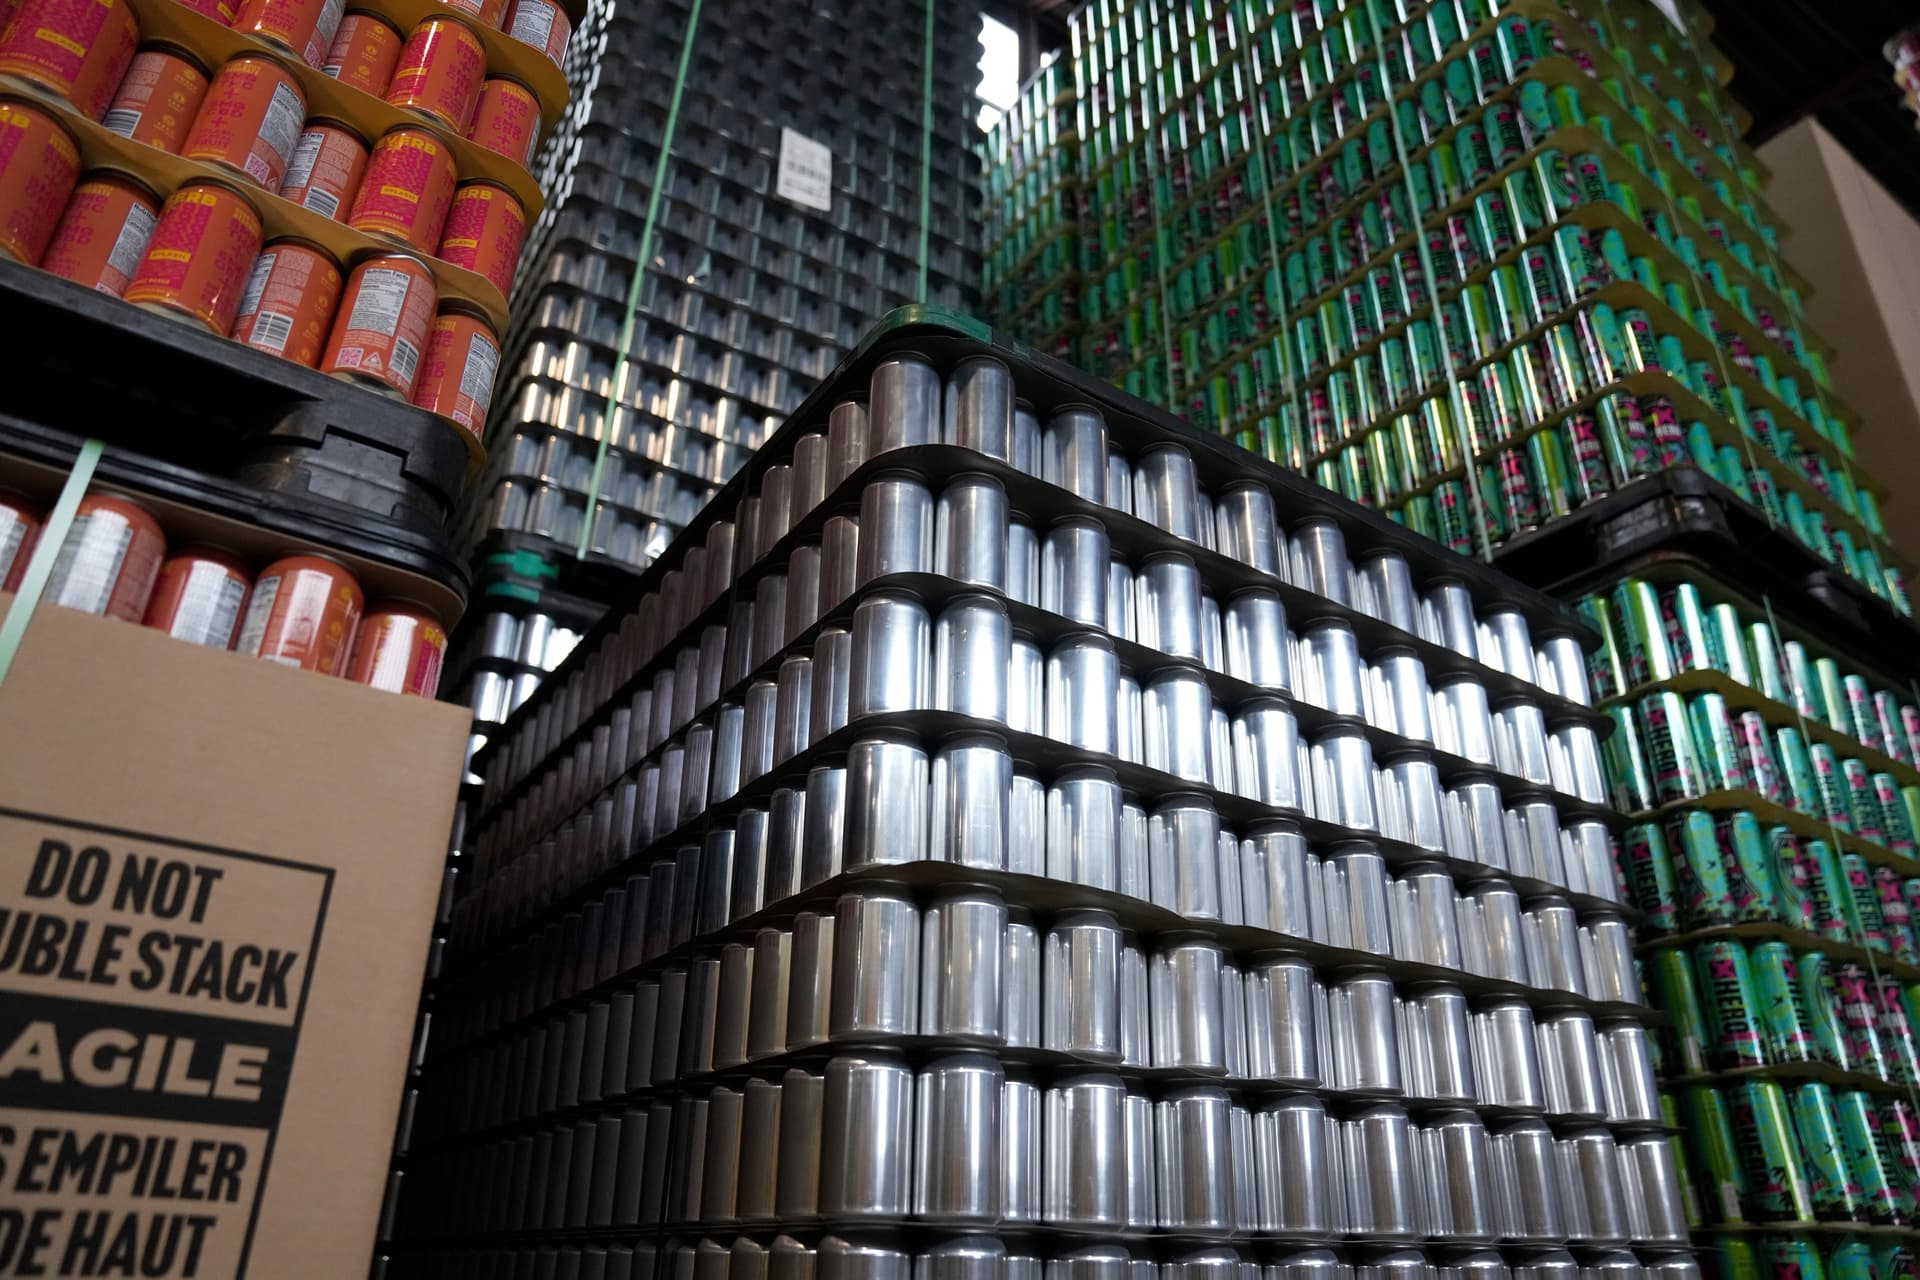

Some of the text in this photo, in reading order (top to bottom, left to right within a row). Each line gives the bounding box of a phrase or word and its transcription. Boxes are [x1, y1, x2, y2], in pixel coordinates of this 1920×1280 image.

[25, 838, 224, 924] DO NOT
[0, 908, 298, 1009] UBLE STACK
[1713, 981, 1749, 1033] HERO
[0, 1020, 270, 1101] AGILE
[14, 1126, 248, 1203] EMPILER
[58, 1208, 217, 1280] HAUT
